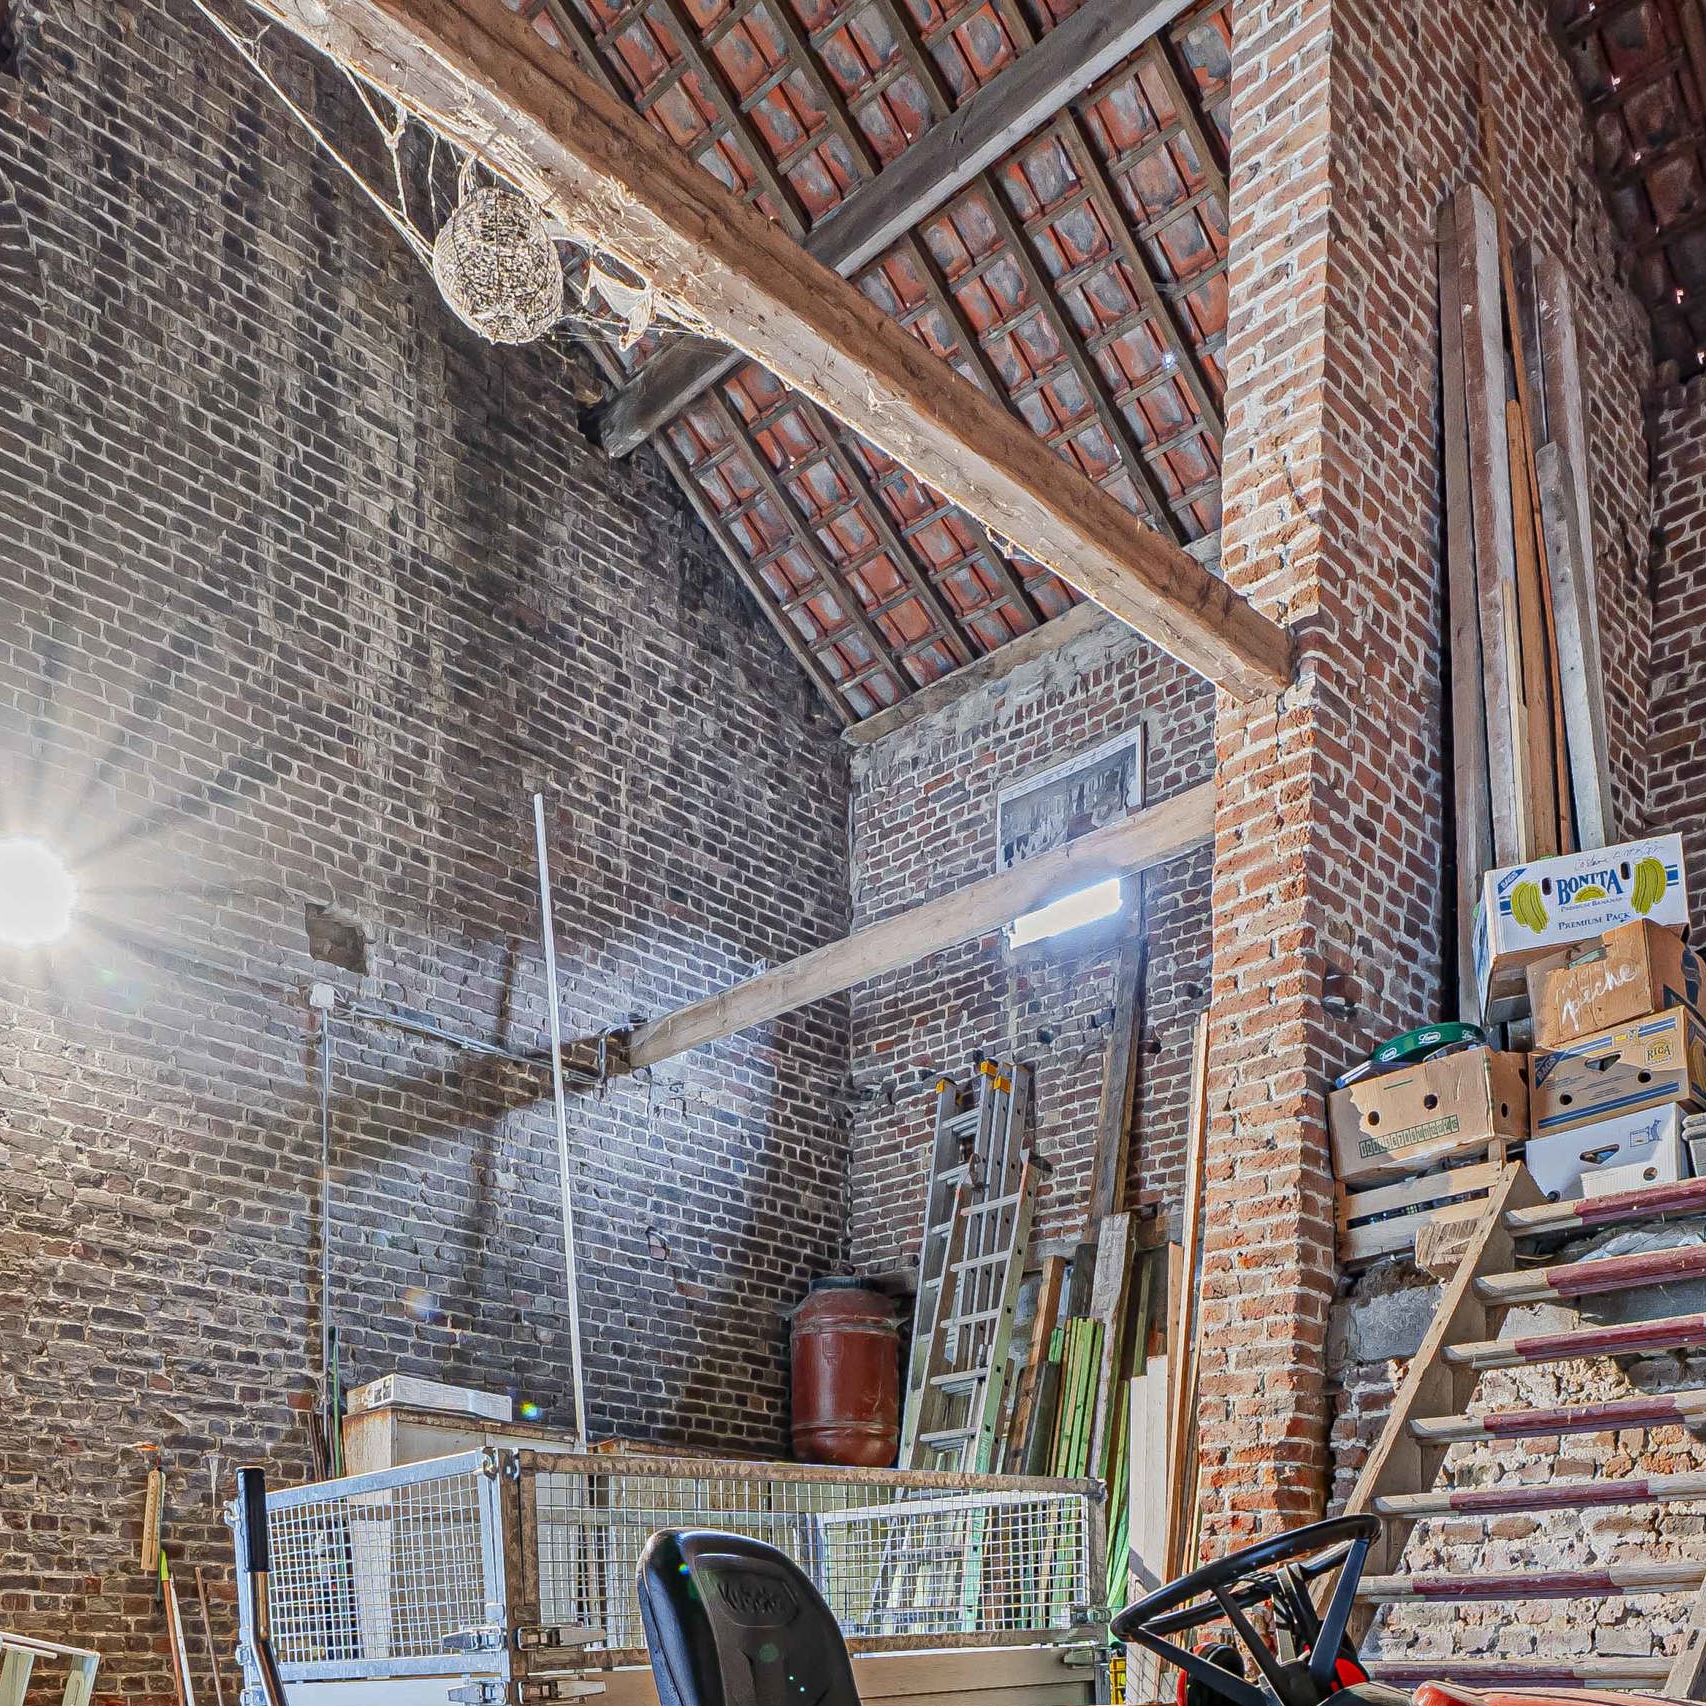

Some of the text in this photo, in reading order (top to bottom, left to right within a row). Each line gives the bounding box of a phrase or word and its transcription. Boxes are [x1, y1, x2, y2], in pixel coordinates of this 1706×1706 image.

[1555, 868, 1624, 906] BONITA
[1558, 911, 1631, 931] PREMIUM PACK
[1646, 1044, 1672, 1062] RICA
